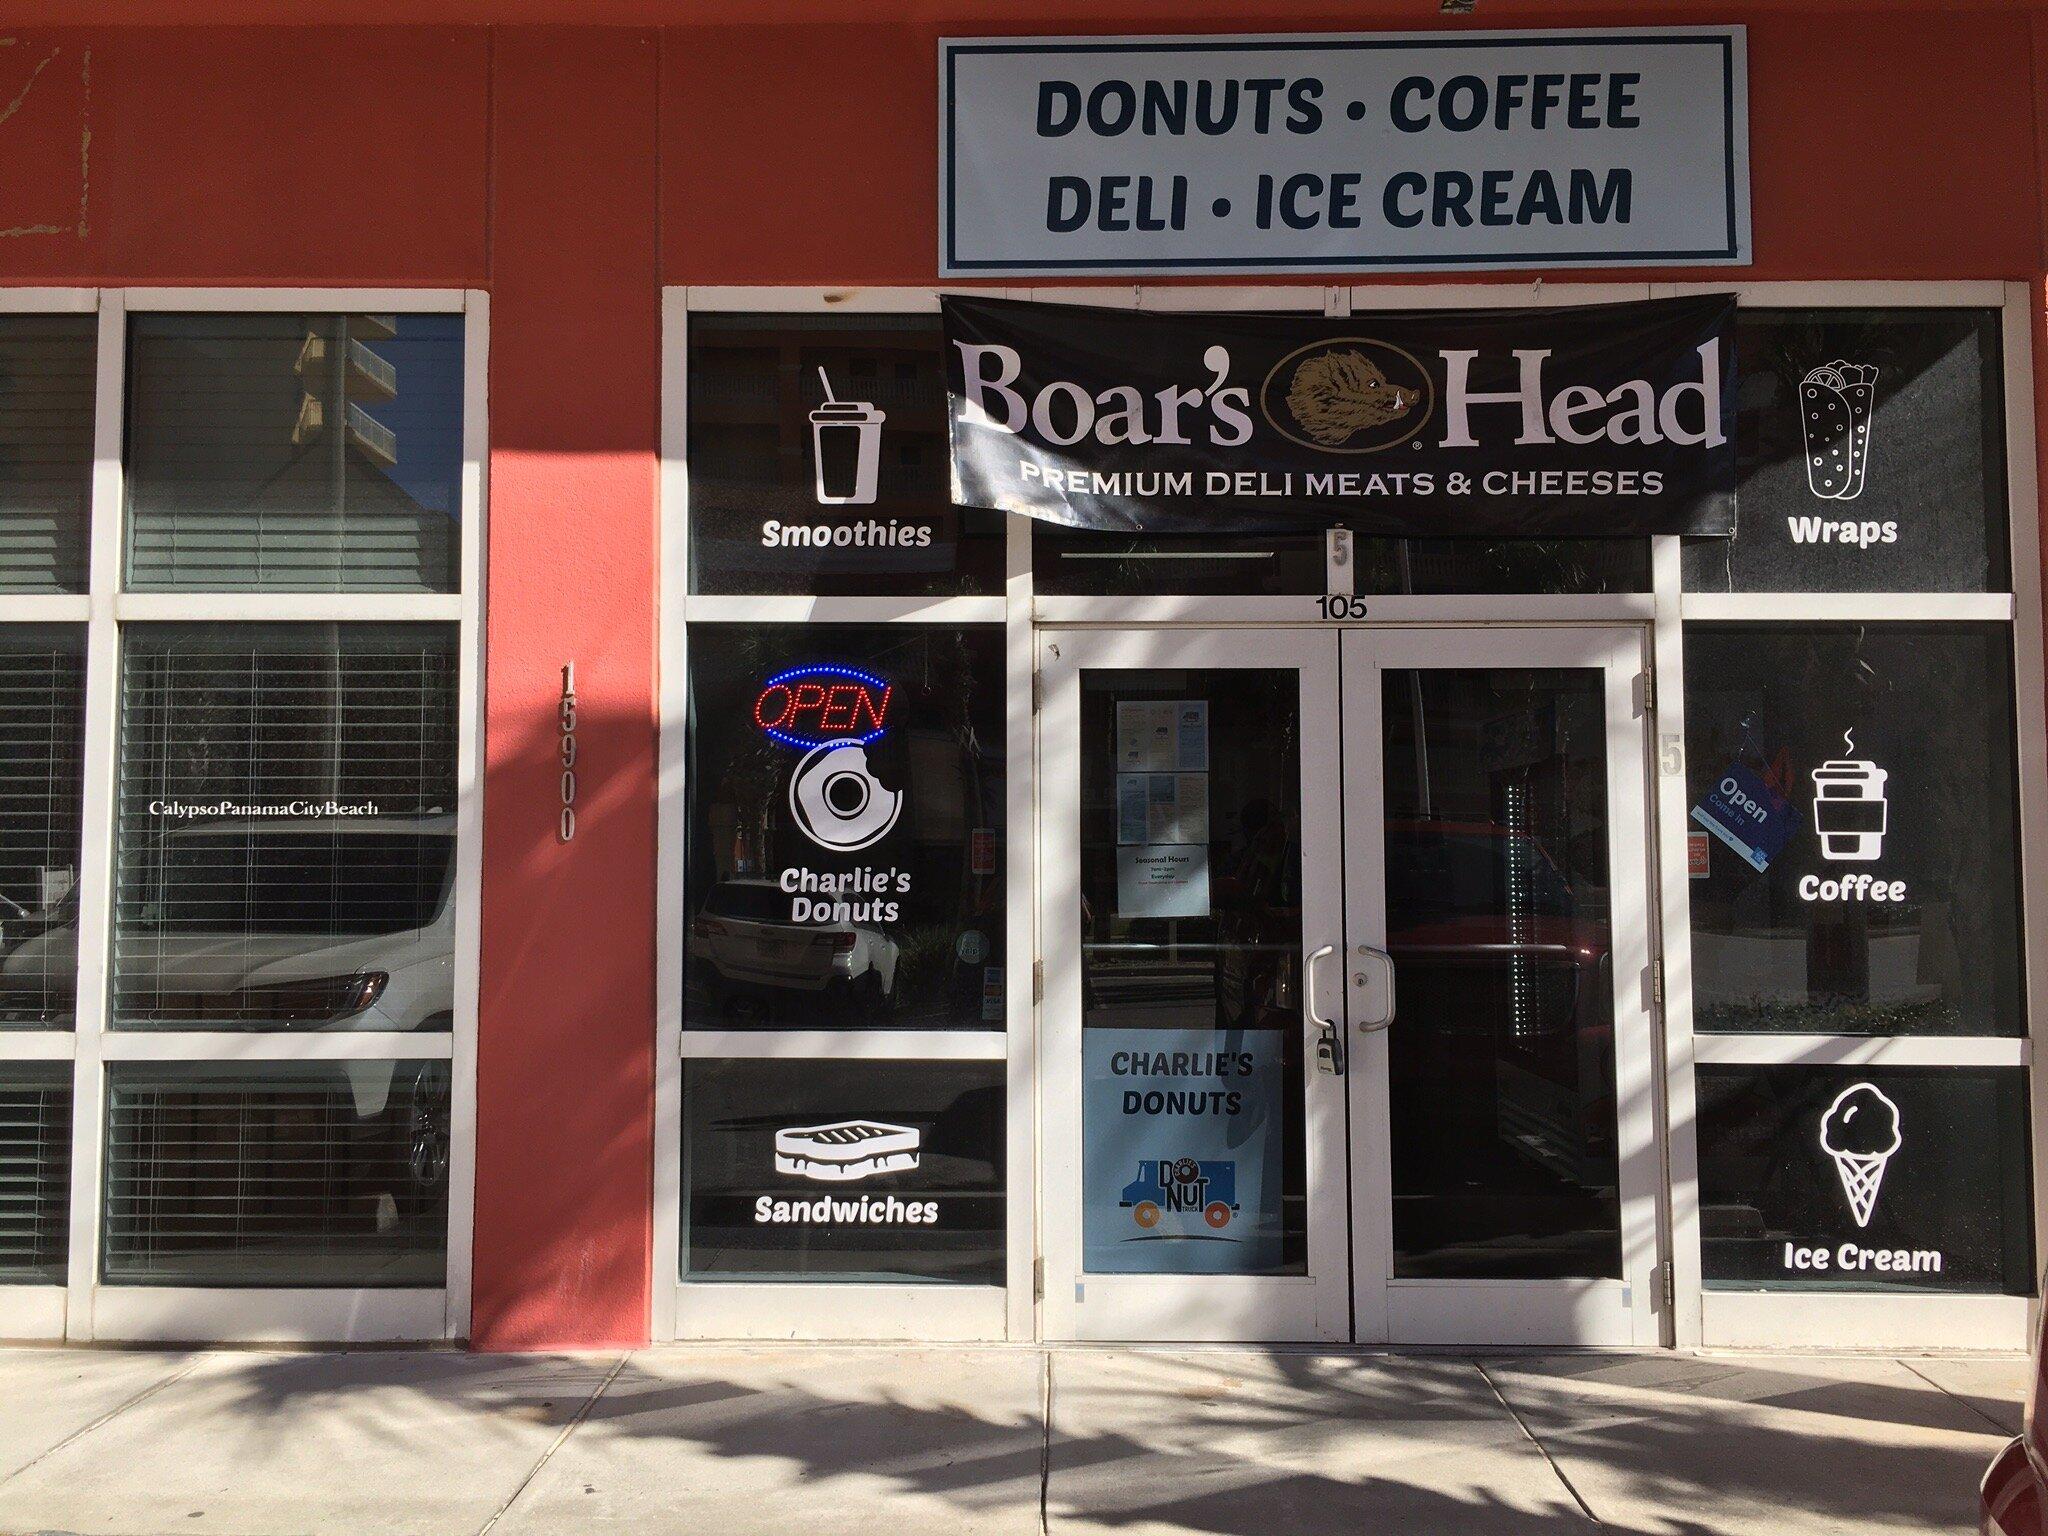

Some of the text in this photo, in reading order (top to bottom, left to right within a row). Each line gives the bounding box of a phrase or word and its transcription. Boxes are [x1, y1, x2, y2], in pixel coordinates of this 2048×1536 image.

[1036, 72, 1641, 138] DONUTS COFFEE
[1046, 167, 1633, 233] DELI ICE CREAM
[952, 336, 1727, 449] Boar's Head
[1020, 460, 1664, 497] PREMIUM DELI MEATS & CHEESES
[761, 519, 932, 548] Smoothies
[1787, 516, 1898, 550] Wraps
[1315, 595, 1368, 620] 105
[755, 682, 894, 730] OPEN
[560, 661, 577, 841] 15900
[1661, 734, 1683, 776] 5
[148, 800, 379, 818] CalypsoPanamaCityBeach
[1709, 793, 1745, 826] Come in
[1719, 776, 1768, 824] Open
[1134, 855, 1190, 864] Seasonal Hours
[779, 866, 911, 893] Charlie's
[1798, 873, 1907, 902] Coffee
[791, 897, 899, 922] Donuts
[1110, 1051, 1254, 1077] CHARLIE'S
[1122, 1090, 1242, 1115] DONUTS
[754, 1194, 939, 1224] Sandwiches
[1784, 1241, 1942, 1273] Ice Cream
